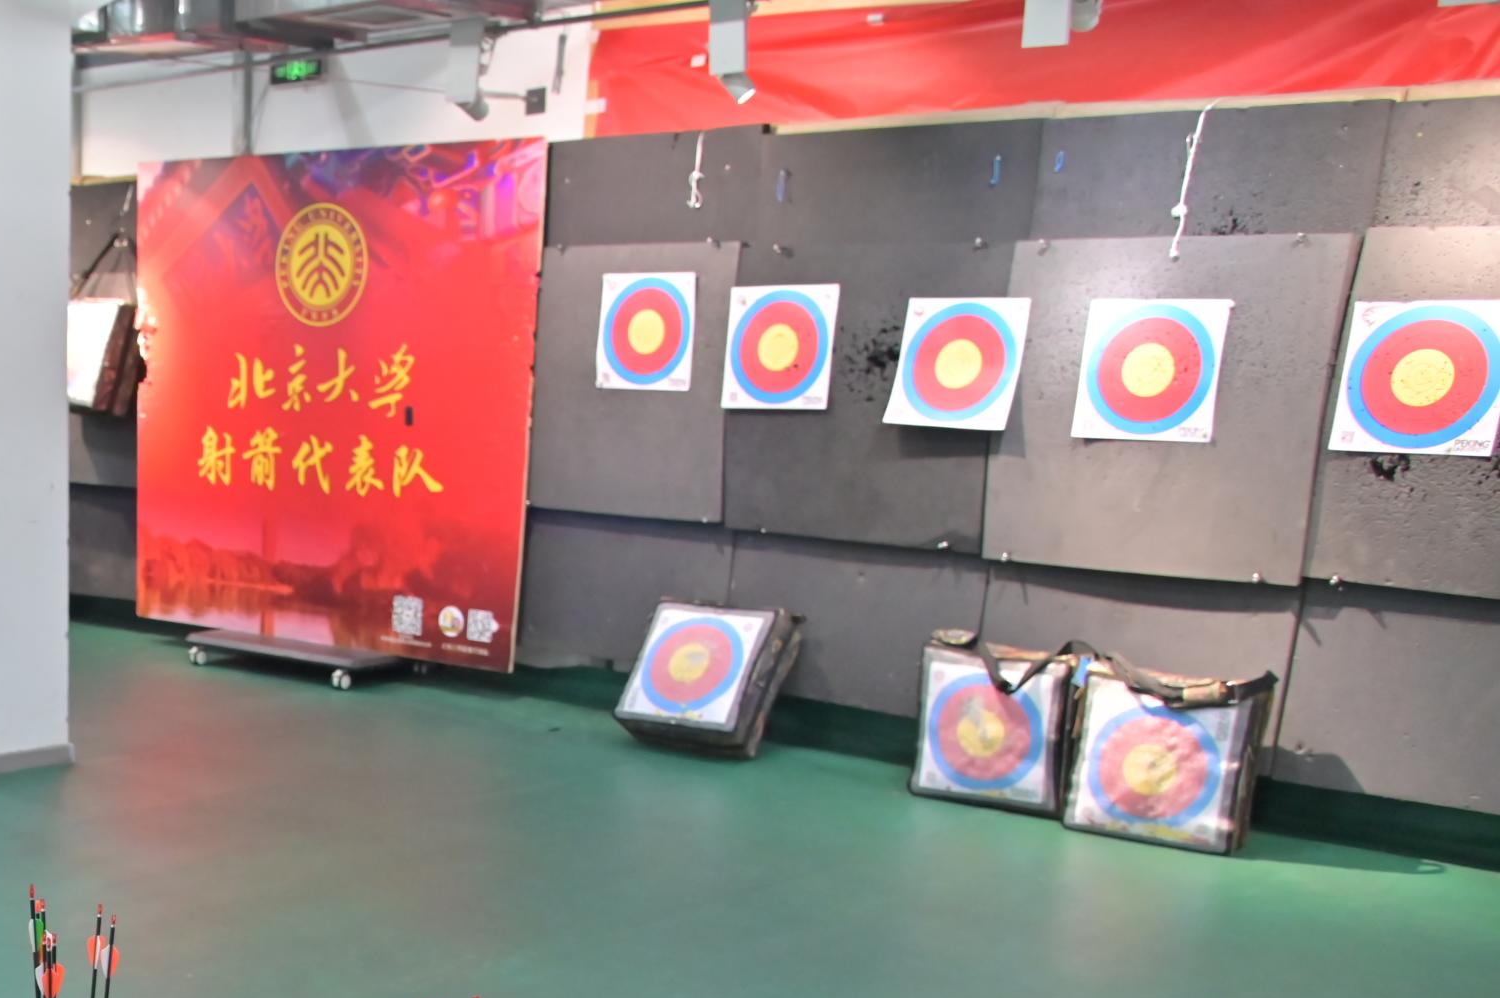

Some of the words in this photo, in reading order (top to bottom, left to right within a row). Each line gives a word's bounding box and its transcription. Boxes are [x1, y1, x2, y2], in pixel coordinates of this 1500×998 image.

[197, 425, 444, 498] 射箭代表队
